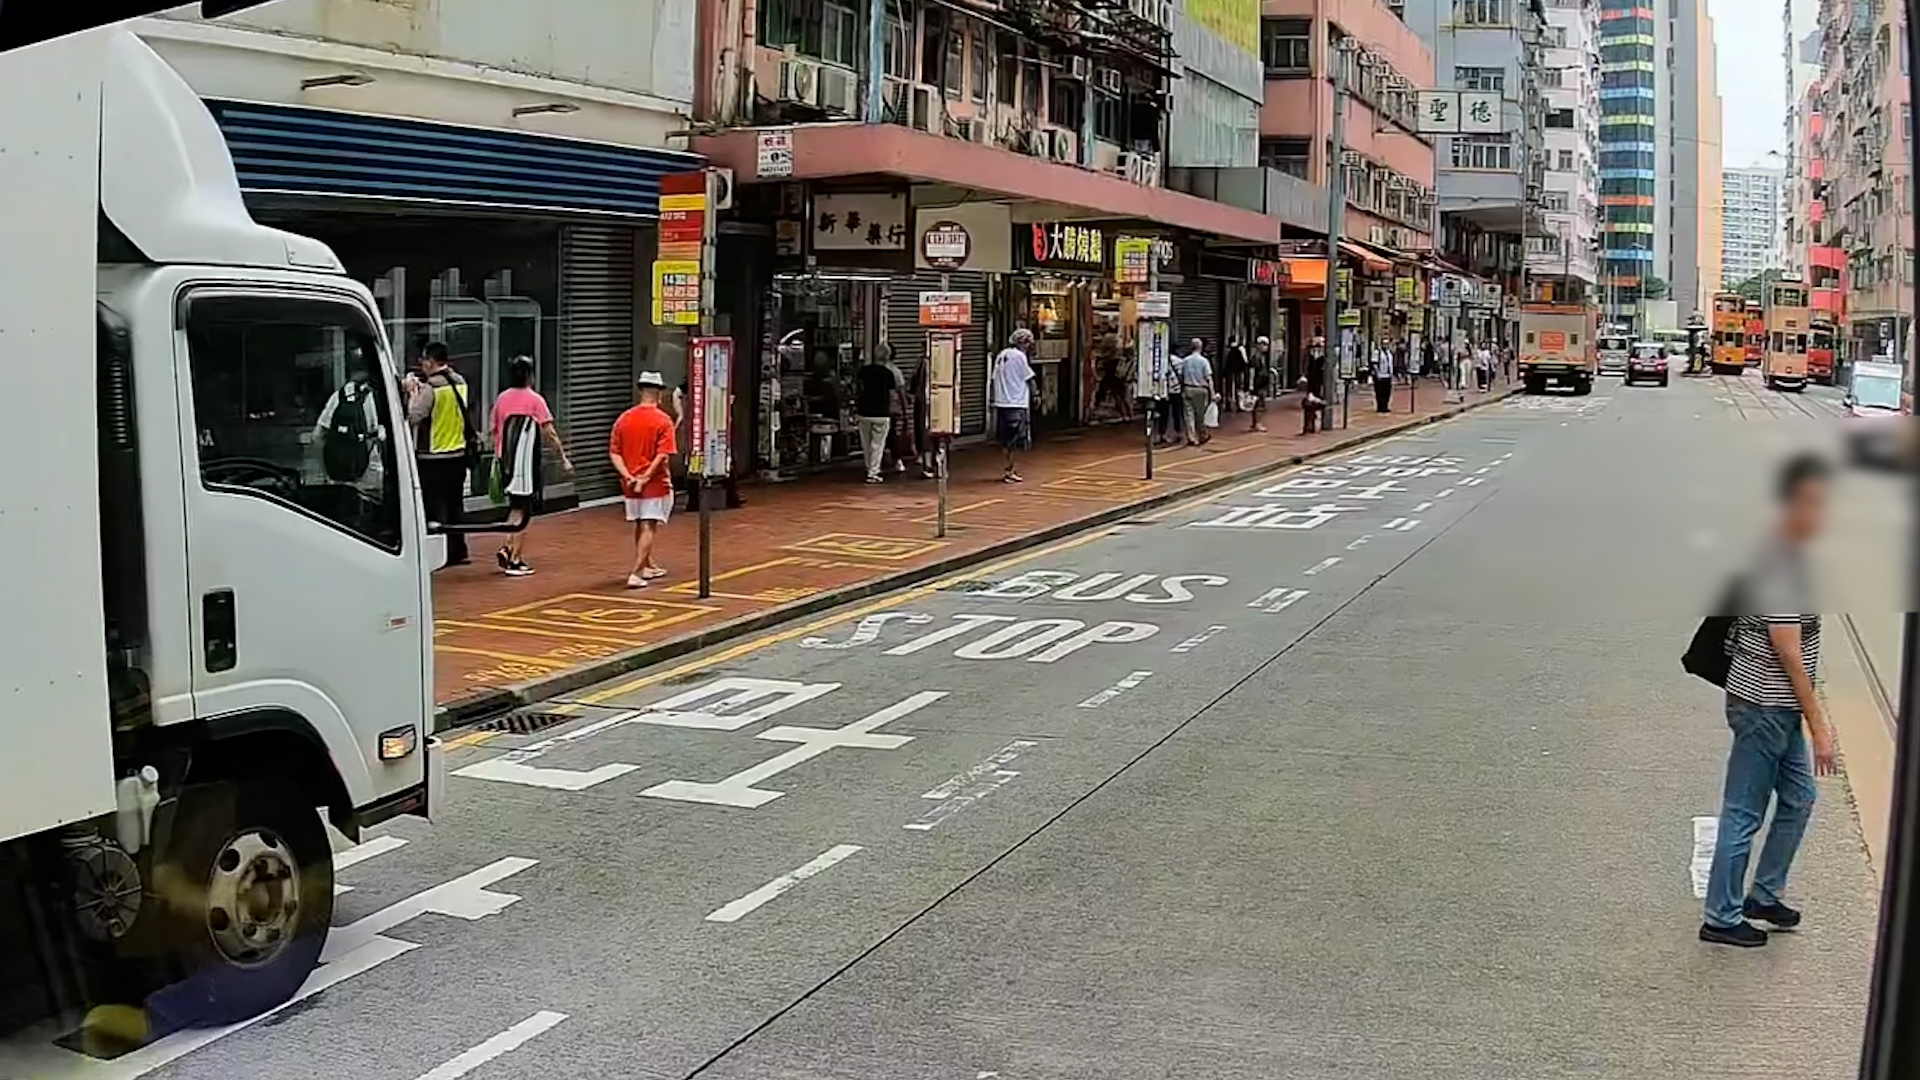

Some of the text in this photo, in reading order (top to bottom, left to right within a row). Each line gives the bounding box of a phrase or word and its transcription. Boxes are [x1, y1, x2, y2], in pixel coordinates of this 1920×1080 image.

[1429, 98, 1492, 123] 聖德
[1300, 466, 1460, 478] STOP
[1250, 479, 1408, 499] 巴士
[1190, 503, 1368, 530] 站
[966, 569, 1229, 604] BUS
[799, 611, 1161, 664] STOP
[449, 676, 951, 809] 巴士
